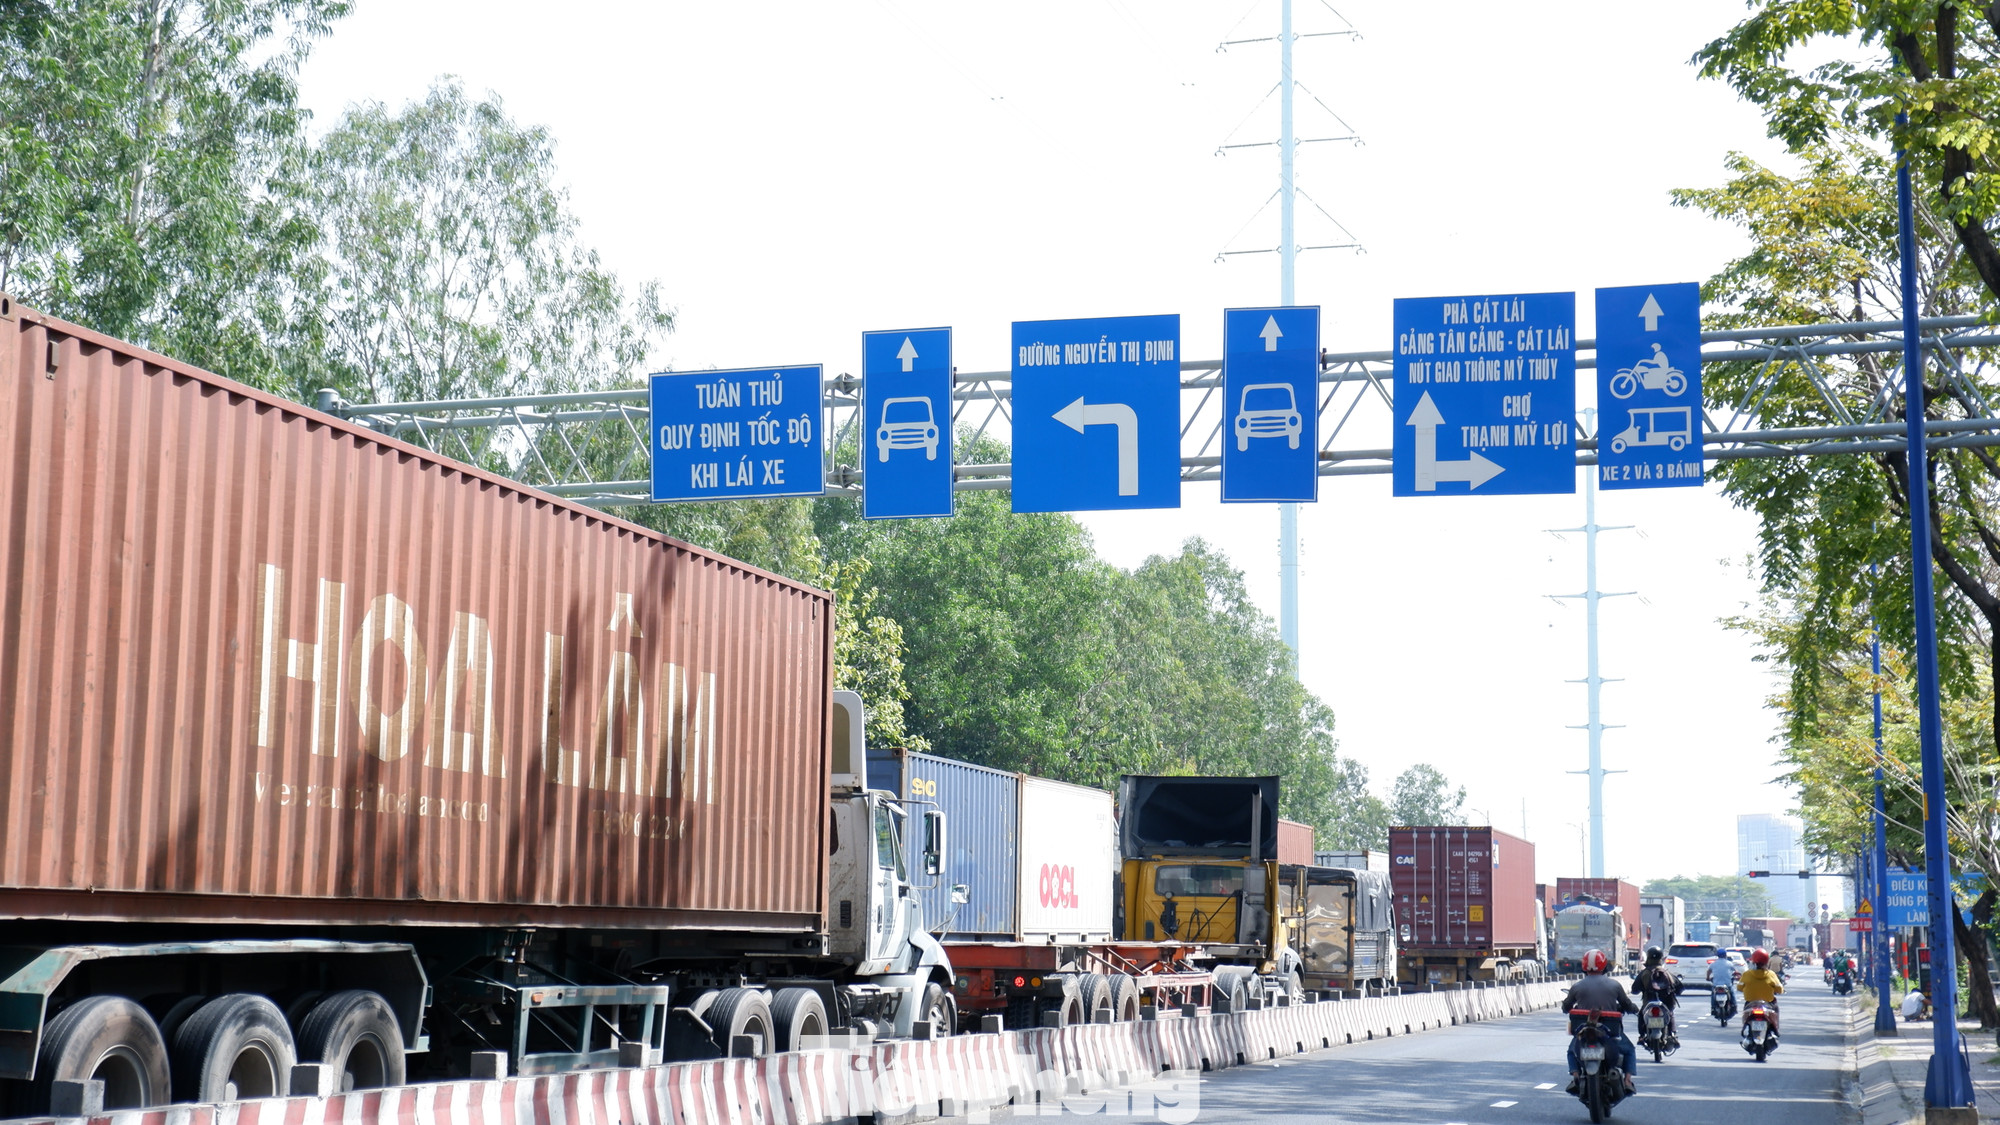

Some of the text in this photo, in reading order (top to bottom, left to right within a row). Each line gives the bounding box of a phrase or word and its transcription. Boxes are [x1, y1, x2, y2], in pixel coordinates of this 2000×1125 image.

[1444, 297, 1524, 324] PHÀ CÁT LÁI
[1019, 335, 1173, 366] ĐƯỜNG NGUYỄN THỊ ĐỊNH
[1400, 328, 1434, 355] CẢNG
[1439, 329, 1465, 353] TÂN
[1470, 326, 1504, 352] CẢNG
[1518, 326, 1543, 351] CÁT
[1548, 325, 1568, 350] LÁI
[1410, 353, 1557, 383] NÚT GIAO THÔNG MỸ THỦY
[696, 373, 782, 408] TUÂN THỦ
[1502, 392, 1532, 421] CHỢ
[661, 411, 811, 452] QUY ĐỊNH TỐC ĐỘ
[1461, 420, 1567, 452] THẠNH MỸ LỢI
[692, 455, 784, 488] KHI LÁI XE
[1603, 461, 1699, 480] XE 2 VÀ 3 BÁNH
[251, 563, 718, 806] HOA LÂM
[1039, 862, 1078, 909] OOCL
